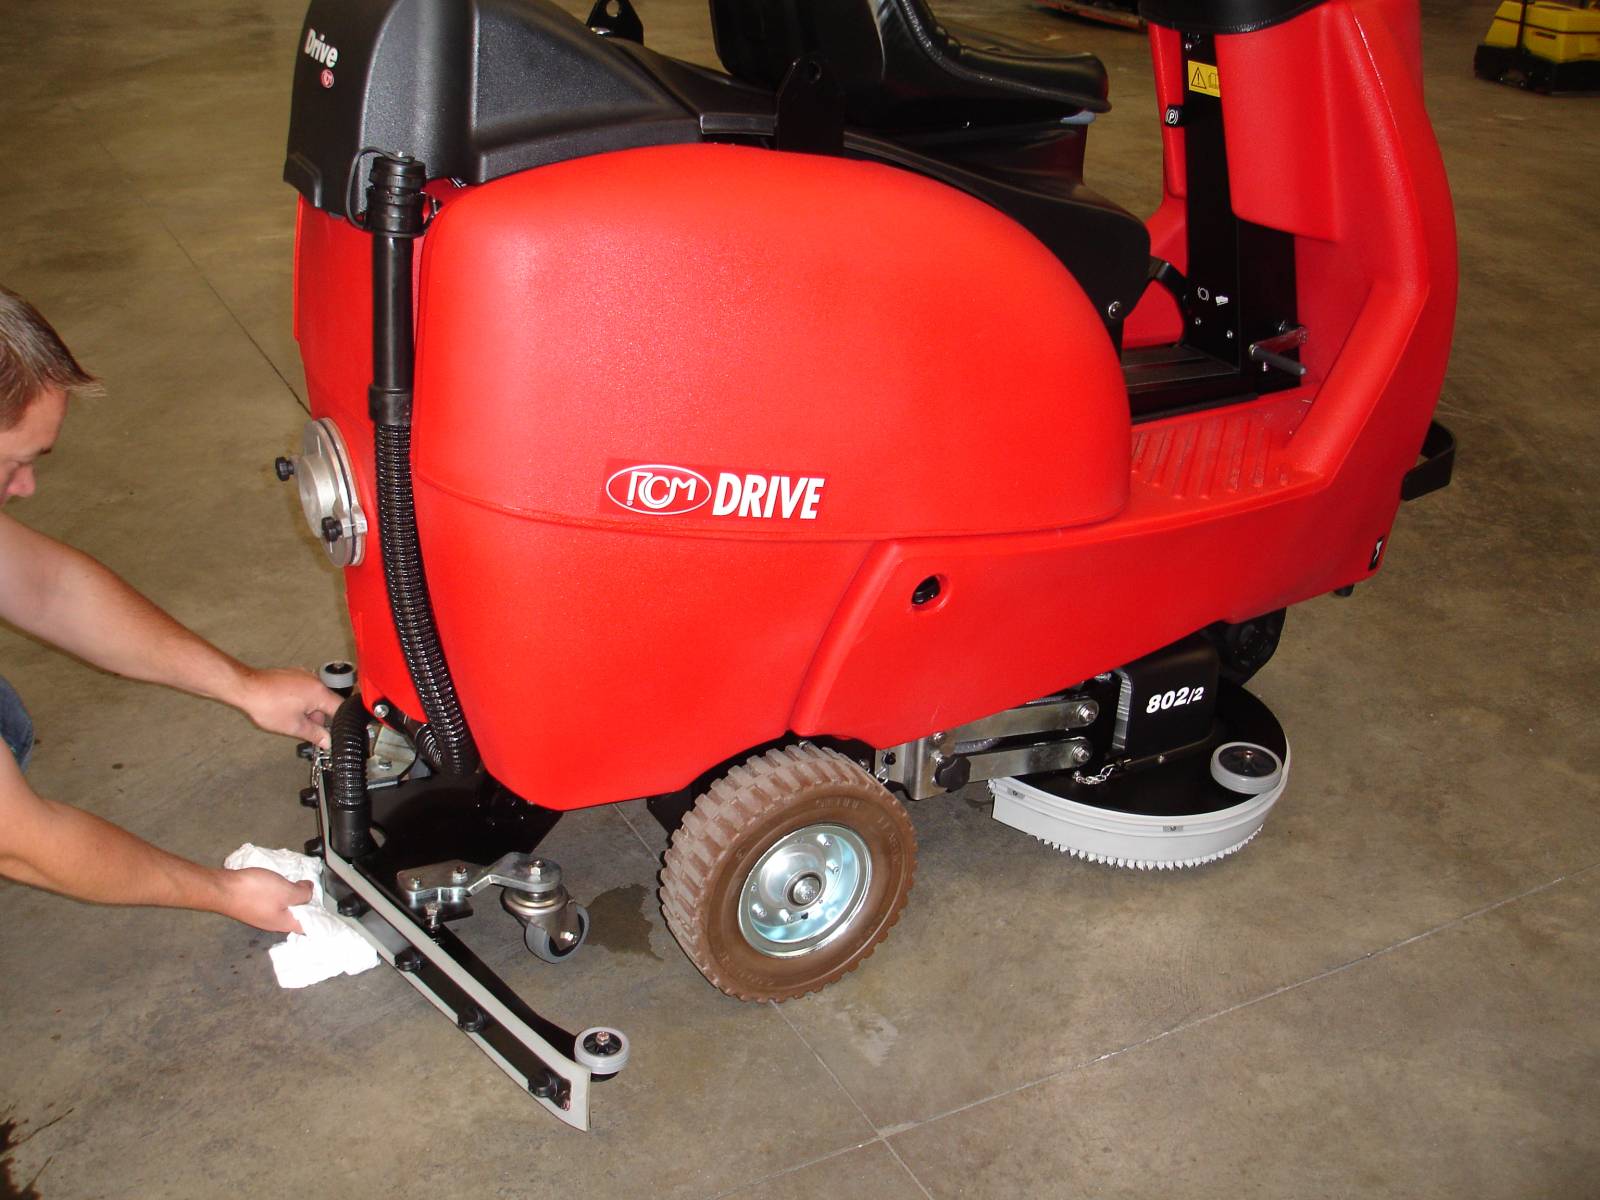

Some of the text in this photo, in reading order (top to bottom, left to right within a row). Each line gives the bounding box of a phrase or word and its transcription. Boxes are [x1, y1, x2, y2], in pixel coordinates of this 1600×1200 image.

[304, 28, 339, 68] Drive
[712, 472, 825, 520] DRIVE
[1146, 686, 1204, 714] 802/2
